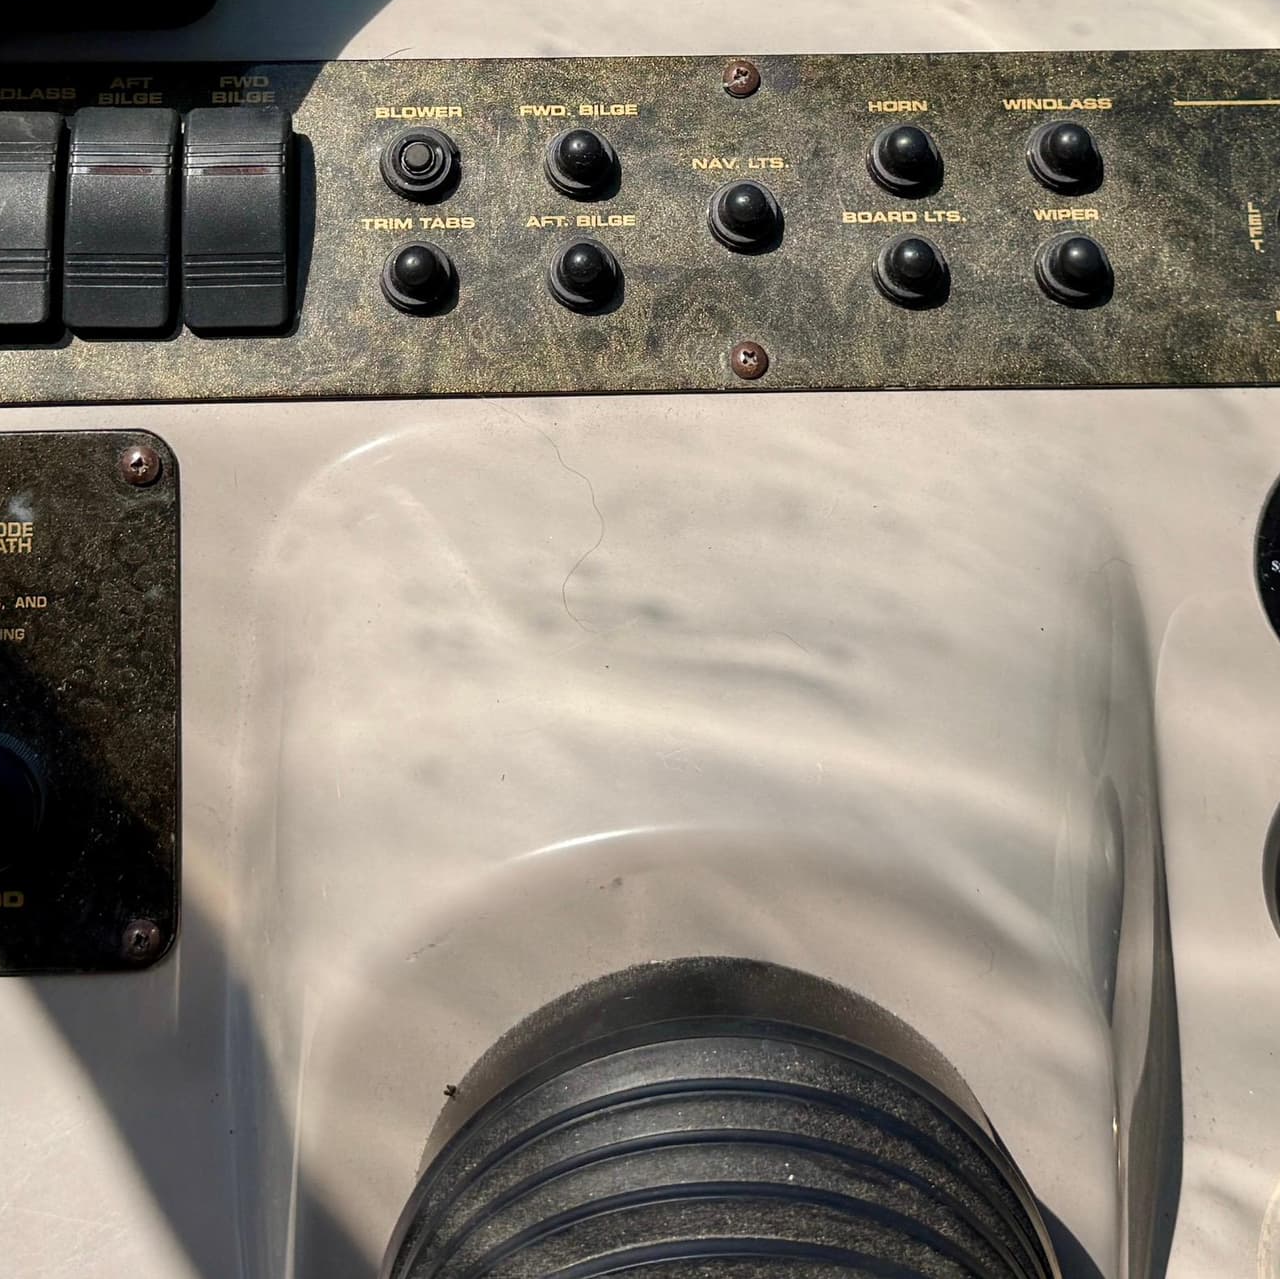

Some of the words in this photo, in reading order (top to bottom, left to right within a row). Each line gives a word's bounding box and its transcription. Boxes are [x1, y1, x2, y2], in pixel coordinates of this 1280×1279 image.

[111, 78, 152, 90] AFT
[220, 76, 269, 88] FWD
[98, 93, 162, 105] BILGE
[212, 91, 275, 105] BILGE
[1003, 98, 1113, 110] WINDLASS
[376, 107, 462, 118] BLOWER
[520, 104, 570, 116] FWD.
[579, 104, 637, 115] BILGE
[868, 101, 928, 112] HORN
[692, 158, 740, 168] NAV.
[748, 158, 789, 168] LTS.
[842, 211, 917, 222] BOARD
[924, 211, 966, 222] LTS.
[1034, 209, 1099, 220] WIPER
[361, 218, 412, 230] TRIM
[420, 217, 475, 228] TABS
[526, 216, 569, 227] AFT.
[576, 215, 635, 226] BILGE
[1248, 202, 1263, 253] LEFT
